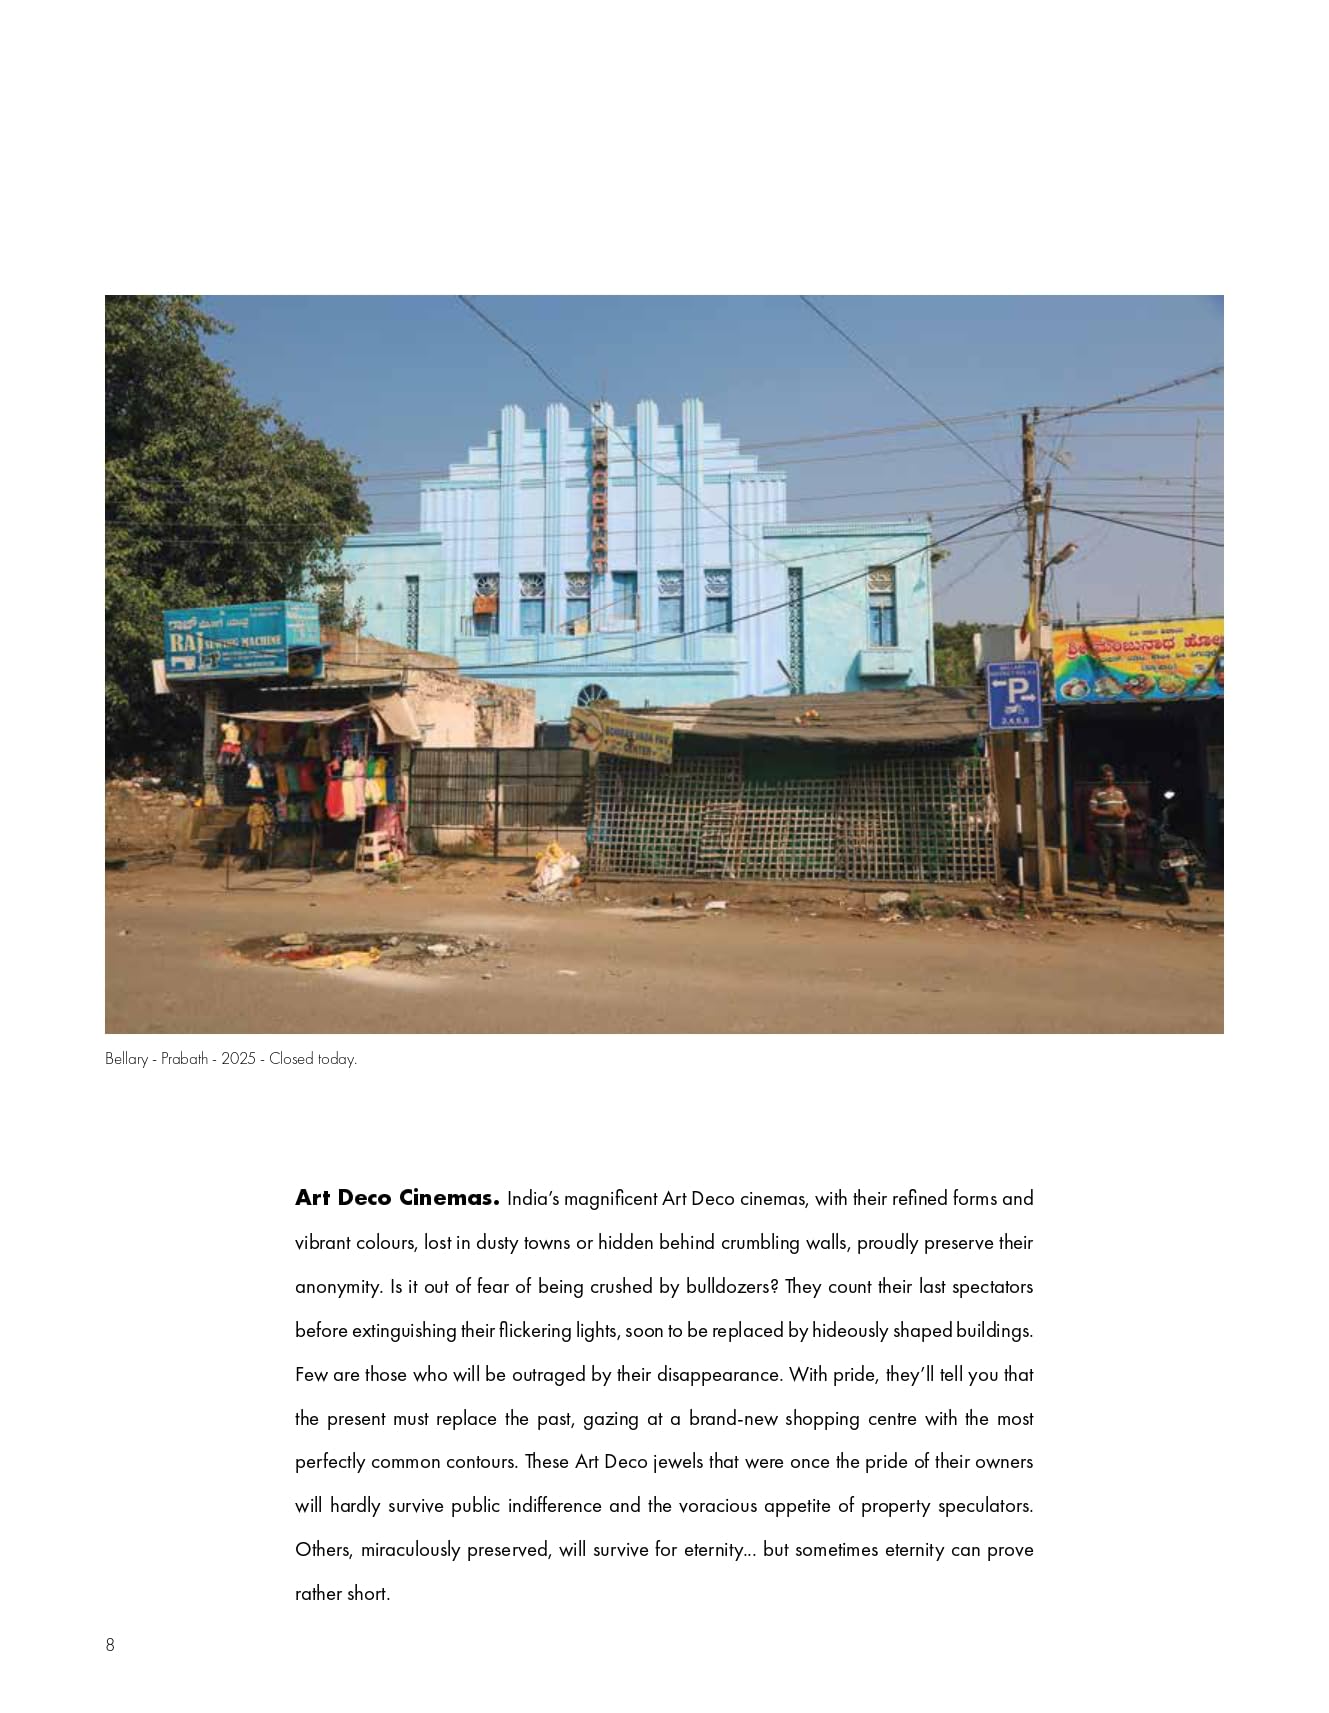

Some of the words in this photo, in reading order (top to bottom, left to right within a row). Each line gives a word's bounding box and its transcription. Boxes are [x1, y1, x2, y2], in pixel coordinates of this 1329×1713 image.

[241, 634, 282, 647] MACHINE
[1008, 678, 1029, 704] P
[105, 1050, 149, 1069] Bellary
[161, 1050, 208, 1065] Prabath
[221, 1051, 256, 1065] 2025
[269, 1050, 314, 1065] Closed
[318, 1050, 357, 1069] today.
[294, 1188, 331, 1206] Art
[338, 1188, 392, 1206] Deco
[399, 1187, 500, 1206] Cinemas.
[564, 1188, 659, 1211] magnificent
[661, 1190, 688, 1206] Art
[692, 1190, 735, 1206] Deco
[740, 1191, 809, 1209] cinemas,
[814, 1188, 848, 1207] with
[852, 1188, 888, 1206] their
[892, 1188, 948, 1206] refined
[952, 1188, 998, 1206] forms
[1002, 1188, 1034, 1206] and
[294, 1232, 352, 1251] vibrant
[356, 1232, 418, 1253] colours,
[424, 1232, 453, 1250] lost
[456, 1235, 471, 1250] in
[476, 1232, 519, 1255] dusty
[523, 1236, 571, 1251] towns
[576, 1239, 594, 1250] or
[598, 1232, 654, 1250] hidden
[659, 1232, 715, 1250] behind
[721, 1232, 800, 1255] crumbling
[805, 1232, 851, 1253] walls,
[857, 1232, 919, 1255] proudly
[924, 1239, 994, 1255] preserve
[998, 1232, 1034, 1250] their
[295, 1279, 383, 1299] anonymity.
[391, 1278, 403, 1294] Is
[408, 1279, 419, 1294] it
[424, 1280, 450, 1294] out
[455, 1276, 472, 1294] of
[477, 1276, 510, 1294] fear
[515, 1276, 532, 1294] of
[538, 1276, 584, 1299] being
[590, 1276, 653, 1294] crushed
[659, 1276, 680, 1299] by
[686, 1276, 779, 1294] bulldozers?
[784, 1276, 822, 1299] They
[828, 1280, 873, 1294] count
[877, 1276, 913, 1294] their
[919, 1276, 947, 1294] last
[952, 1280, 1034, 1299] spectators
[295, 1320, 348, 1338] before
[352, 1320, 457, 1343] extinguishing
[460, 1320, 496, 1338] their
[498, 1320, 572, 1343] flickering
[576, 1320, 621, 1343] lights,
[625, 1327, 664, 1338] soon
[667, 1324, 683, 1338] to
[687, 1320, 708, 1338] be
[712, 1320, 784, 1343] replaced
[788, 1320, 809, 1343] by
[812, 1320, 889, 1343] hideously
[893, 1320, 953, 1343] shaped
[956, 1320, 1033, 1343] buildings.
[296, 1366, 329, 1383] Few
[333, 1371, 360, 1382] are
[364, 1364, 407, 1382] those
[412, 1364, 448, 1383] who
[452, 1364, 480, 1383] will
[485, 1364, 506, 1382] be
[512, 1364, 586, 1387] outraged
[591, 1364, 612, 1387] by
[616, 1364, 652, 1382] their
[657, 1364, 783, 1387] disappearance.
[788, 1364, 828, 1383] With
[833, 1364, 879, 1387] pride,
[939, 1364, 963, 1382] tell
[967, 1371, 999, 1387] you
[1003, 1364, 1035, 1382] that
[294, 1408, 319, 1426] the
[327, 1412, 387, 1431] present
[393, 1412, 430, 1426] must
[436, 1408, 497, 1431] replace
[504, 1408, 529, 1426] the
[537, 1412, 575, 1431] past,
[583, 1411, 639, 1431] gazing
[647, 1412, 664, 1426] at
[670, 1415, 681, 1426] a
[689, 1408, 779, 1427] brand-new
[785, 1408, 860, 1431] shopping
[868, 1412, 917, 1426] centre
[924, 1408, 958, 1427] with
[964, 1408, 989, 1426] the
[997, 1412, 1035, 1426] most
[295, 1451, 366, 1474] perfectly
[371, 1458, 441, 1469] common
[446, 1455, 518, 1469] contours.
[524, 1451, 569, 1469] These
[574, 1453, 600, 1469] Art
[605, 1453, 648, 1469] Deco
[653, 1451, 704, 1474] jewels
[709, 1451, 740, 1469] that
[744, 1458, 784, 1470] were
[790, 1458, 830, 1469] once
[835, 1451, 860, 1469] the
[865, 1451, 908, 1474] pride
[914, 1451, 930, 1469] of
[934, 1451, 971, 1469] their
[975, 1458, 1034, 1470] owners
[294, 1495, 322, 1514] will
[330, 1495, 381, 1518] hardly
[388, 1498, 444, 1514] survive
[451, 1495, 501, 1518] public
[508, 1495, 602, 1513] indifference
[609, 1495, 641, 1513] and
[647, 1495, 672, 1513] the
[678, 1498, 758, 1514] voracious
[764, 1498, 831, 1518] appetite
[838, 1495, 855, 1513] of
[861, 1499, 931, 1518] property
[938, 1495, 1033, 1518] speculators.
[295, 1539, 353, 1560] Others,
[361, 1539, 461, 1562] miraculously
[467, 1539, 552, 1562] preserved,
[558, 1539, 586, 1558] will
[593, 1542, 649, 1558] survive
[655, 1539, 678, 1557] for
[684, 1542, 756, 1562] eternity...
[763, 1539, 790, 1557] but
[795, 1542, 879, 1557] sometimes
[885, 1542, 945, 1562] eternity
[951, 1546, 981, 1557] can
[987, 1546, 1034, 1562] prove
[295, 1583, 343, 1601] rather
[347, 1583, 390, 1601] short.
[105, 1637, 115, 1652] 8
